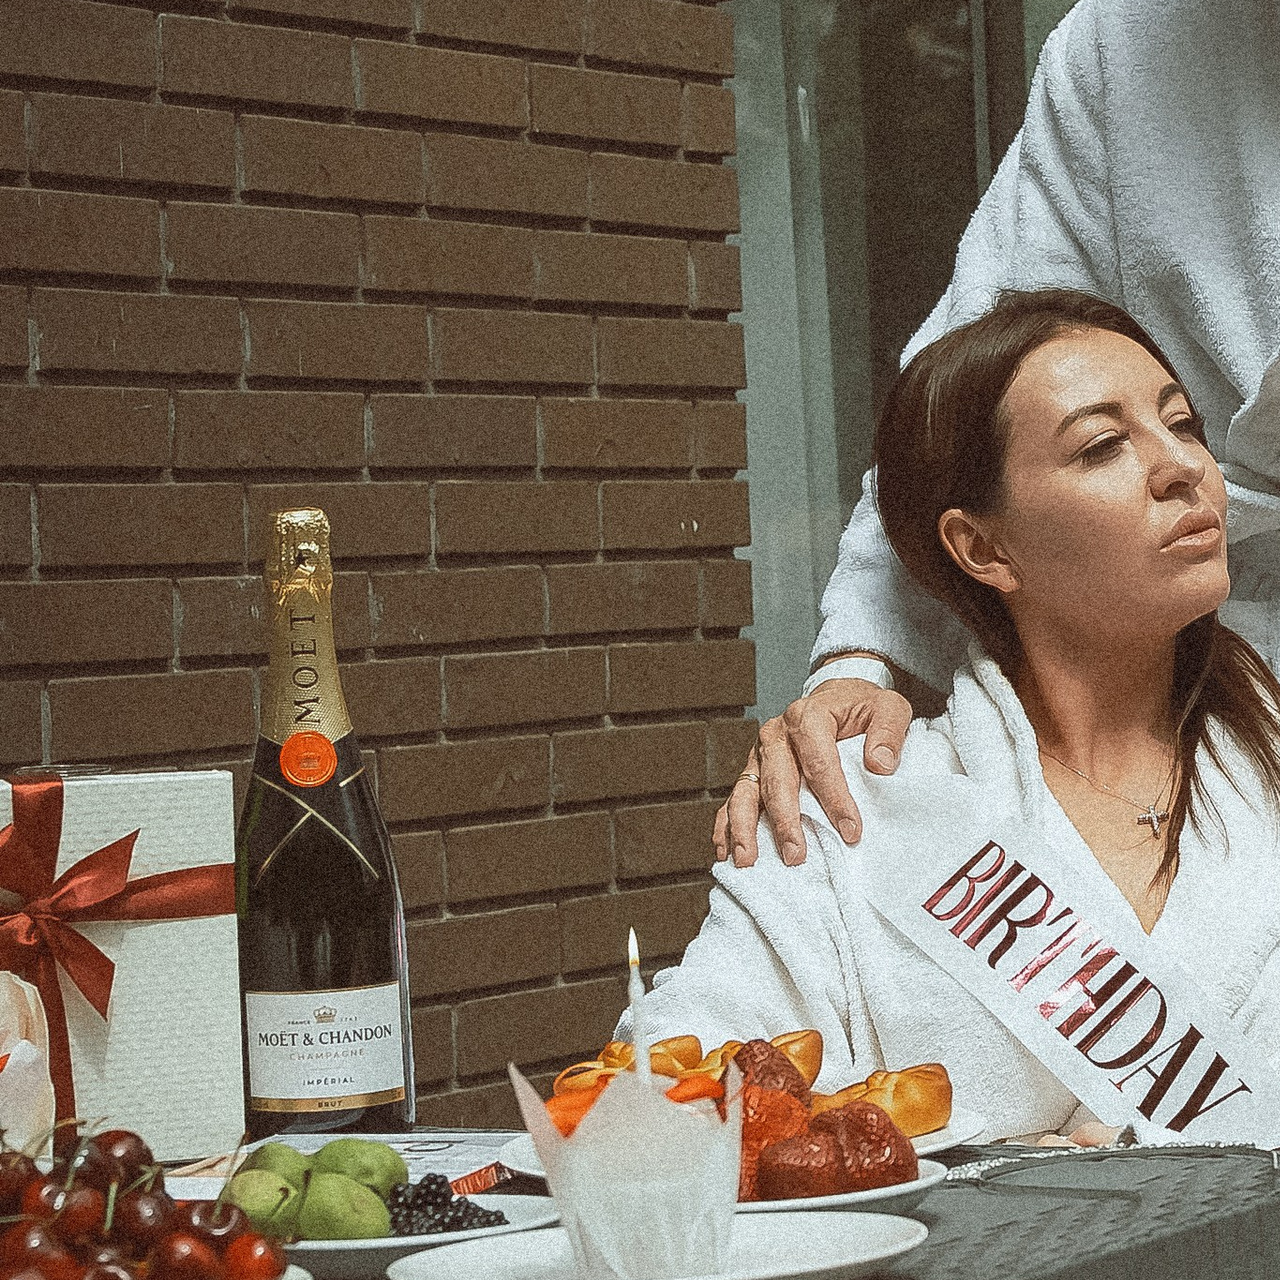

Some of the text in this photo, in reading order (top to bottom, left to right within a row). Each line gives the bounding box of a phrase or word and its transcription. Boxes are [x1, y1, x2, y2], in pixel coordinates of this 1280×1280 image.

[921, 839, 1253, 1133] BIRTHDAY
[258, 1023, 393, 1047] MOËT & CHANDON
[289, 1048, 365, 1061] CHAMPAGNE
[302, 1076, 356, 1086] IMPÉRIAL
[317, 1100, 343, 1108] BRUT
